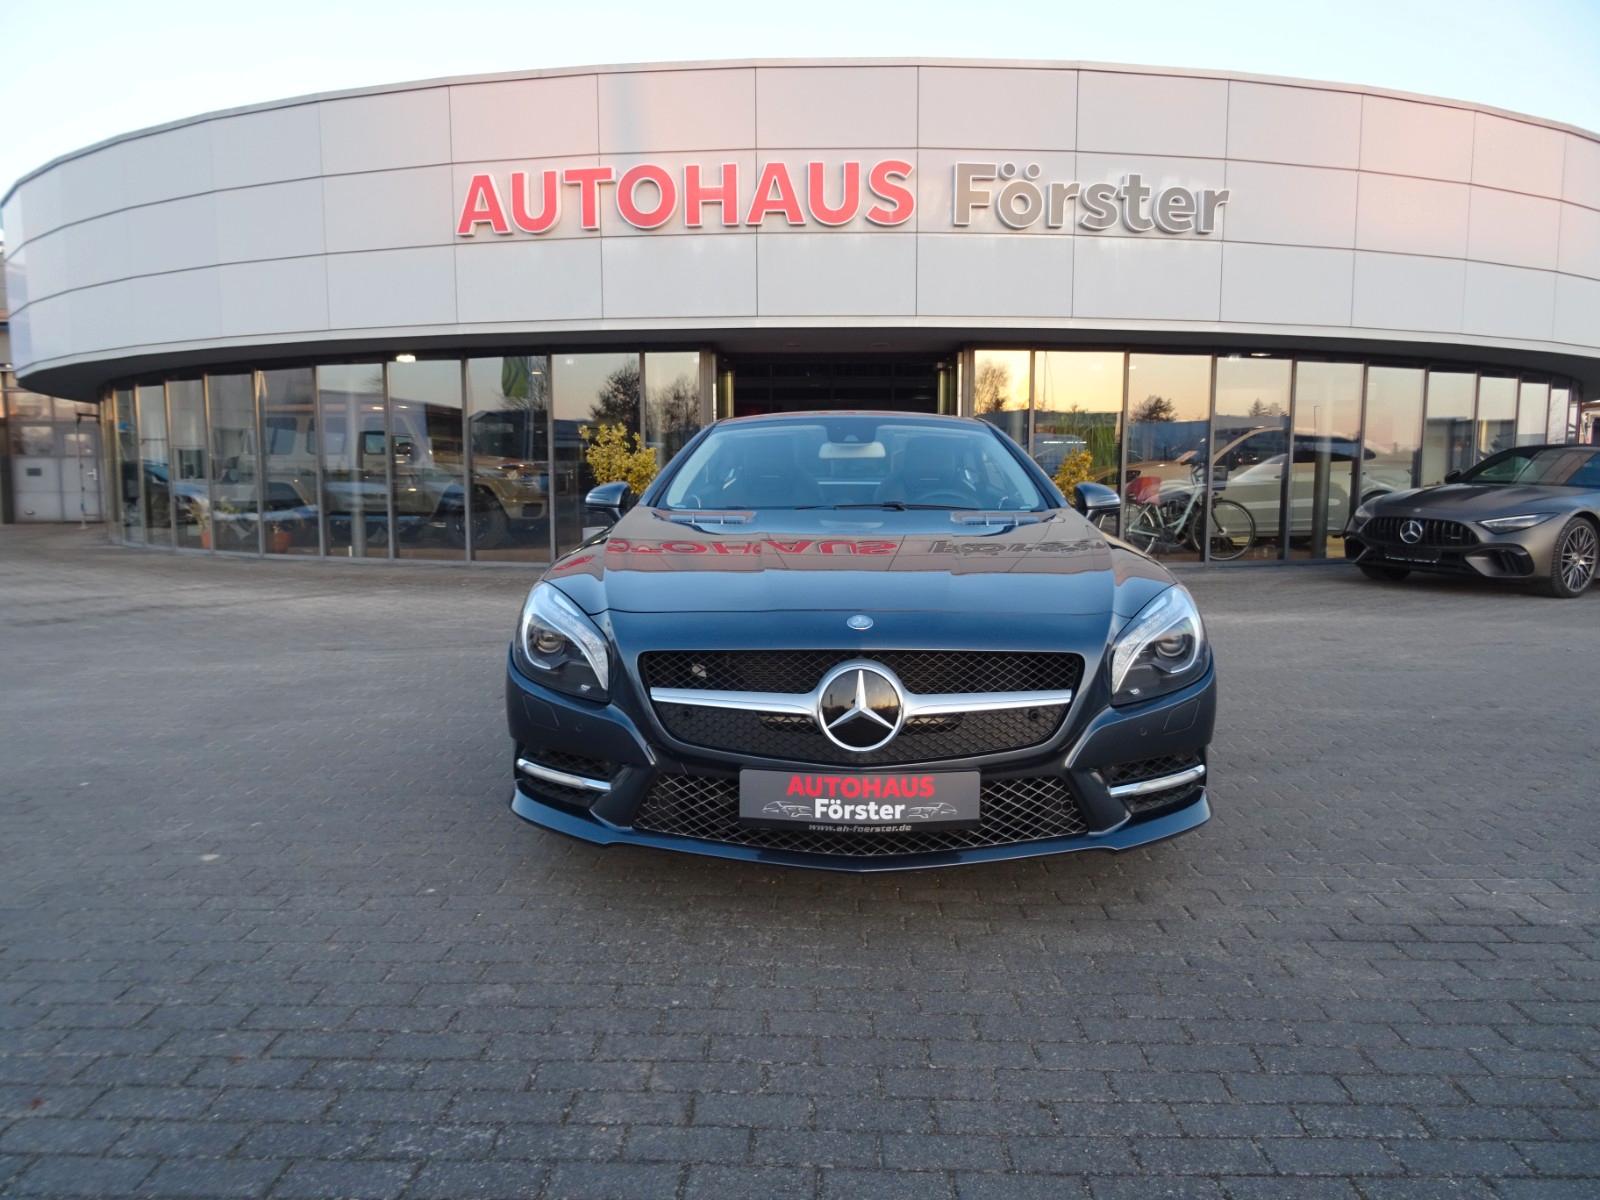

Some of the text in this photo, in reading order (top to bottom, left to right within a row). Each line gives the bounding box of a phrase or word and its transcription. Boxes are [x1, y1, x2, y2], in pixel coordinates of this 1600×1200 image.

[456, 159, 1231, 237] AUTOHAUS Förster
[786, 775, 936, 799] AUTOHAUS
[814, 797, 906, 821] Förster
[808, 823, 913, 833] www.ah-foerster.de
